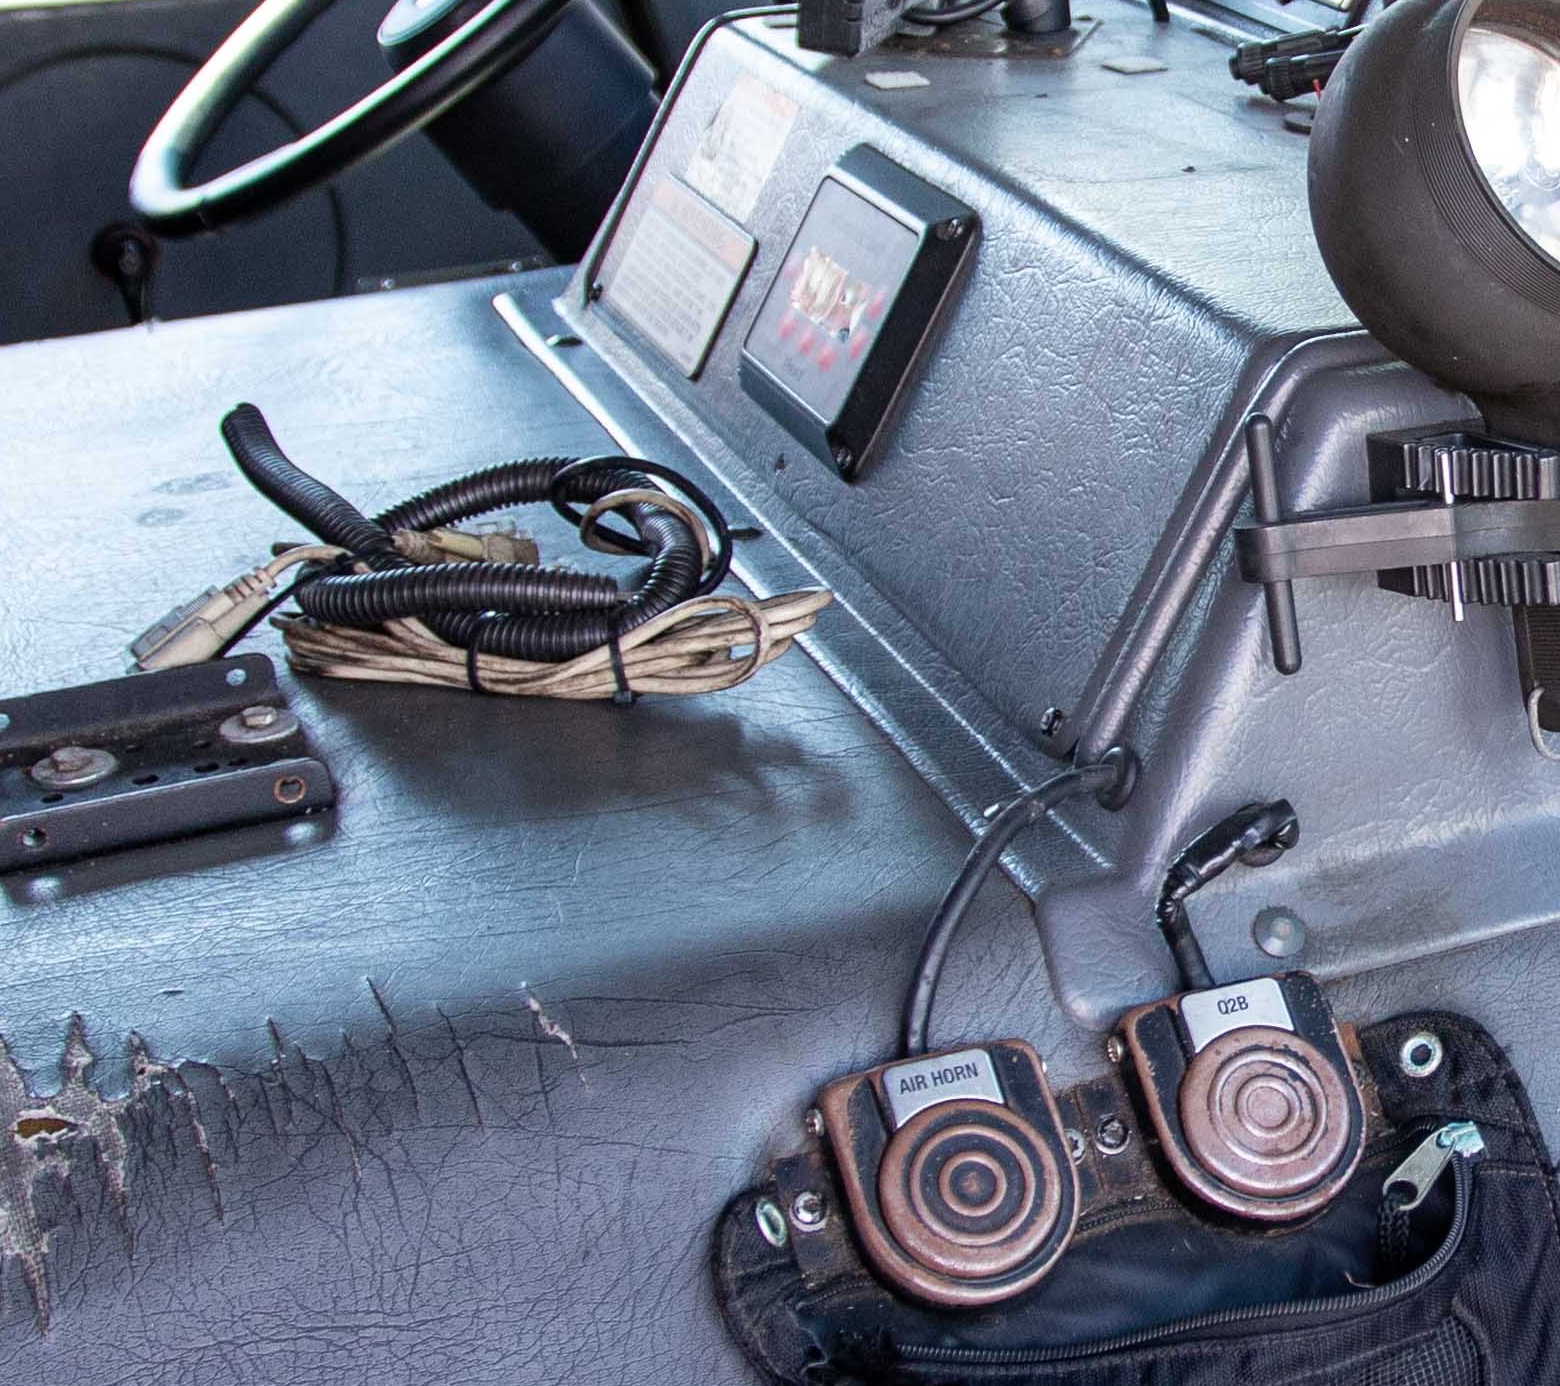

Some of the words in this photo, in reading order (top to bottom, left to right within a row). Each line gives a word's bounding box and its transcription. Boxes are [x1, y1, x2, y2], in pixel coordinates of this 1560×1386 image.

[1216, 995, 1250, 1016] Q2B
[898, 1074, 930, 1096] AIR
[930, 1062, 980, 1088] HORN
